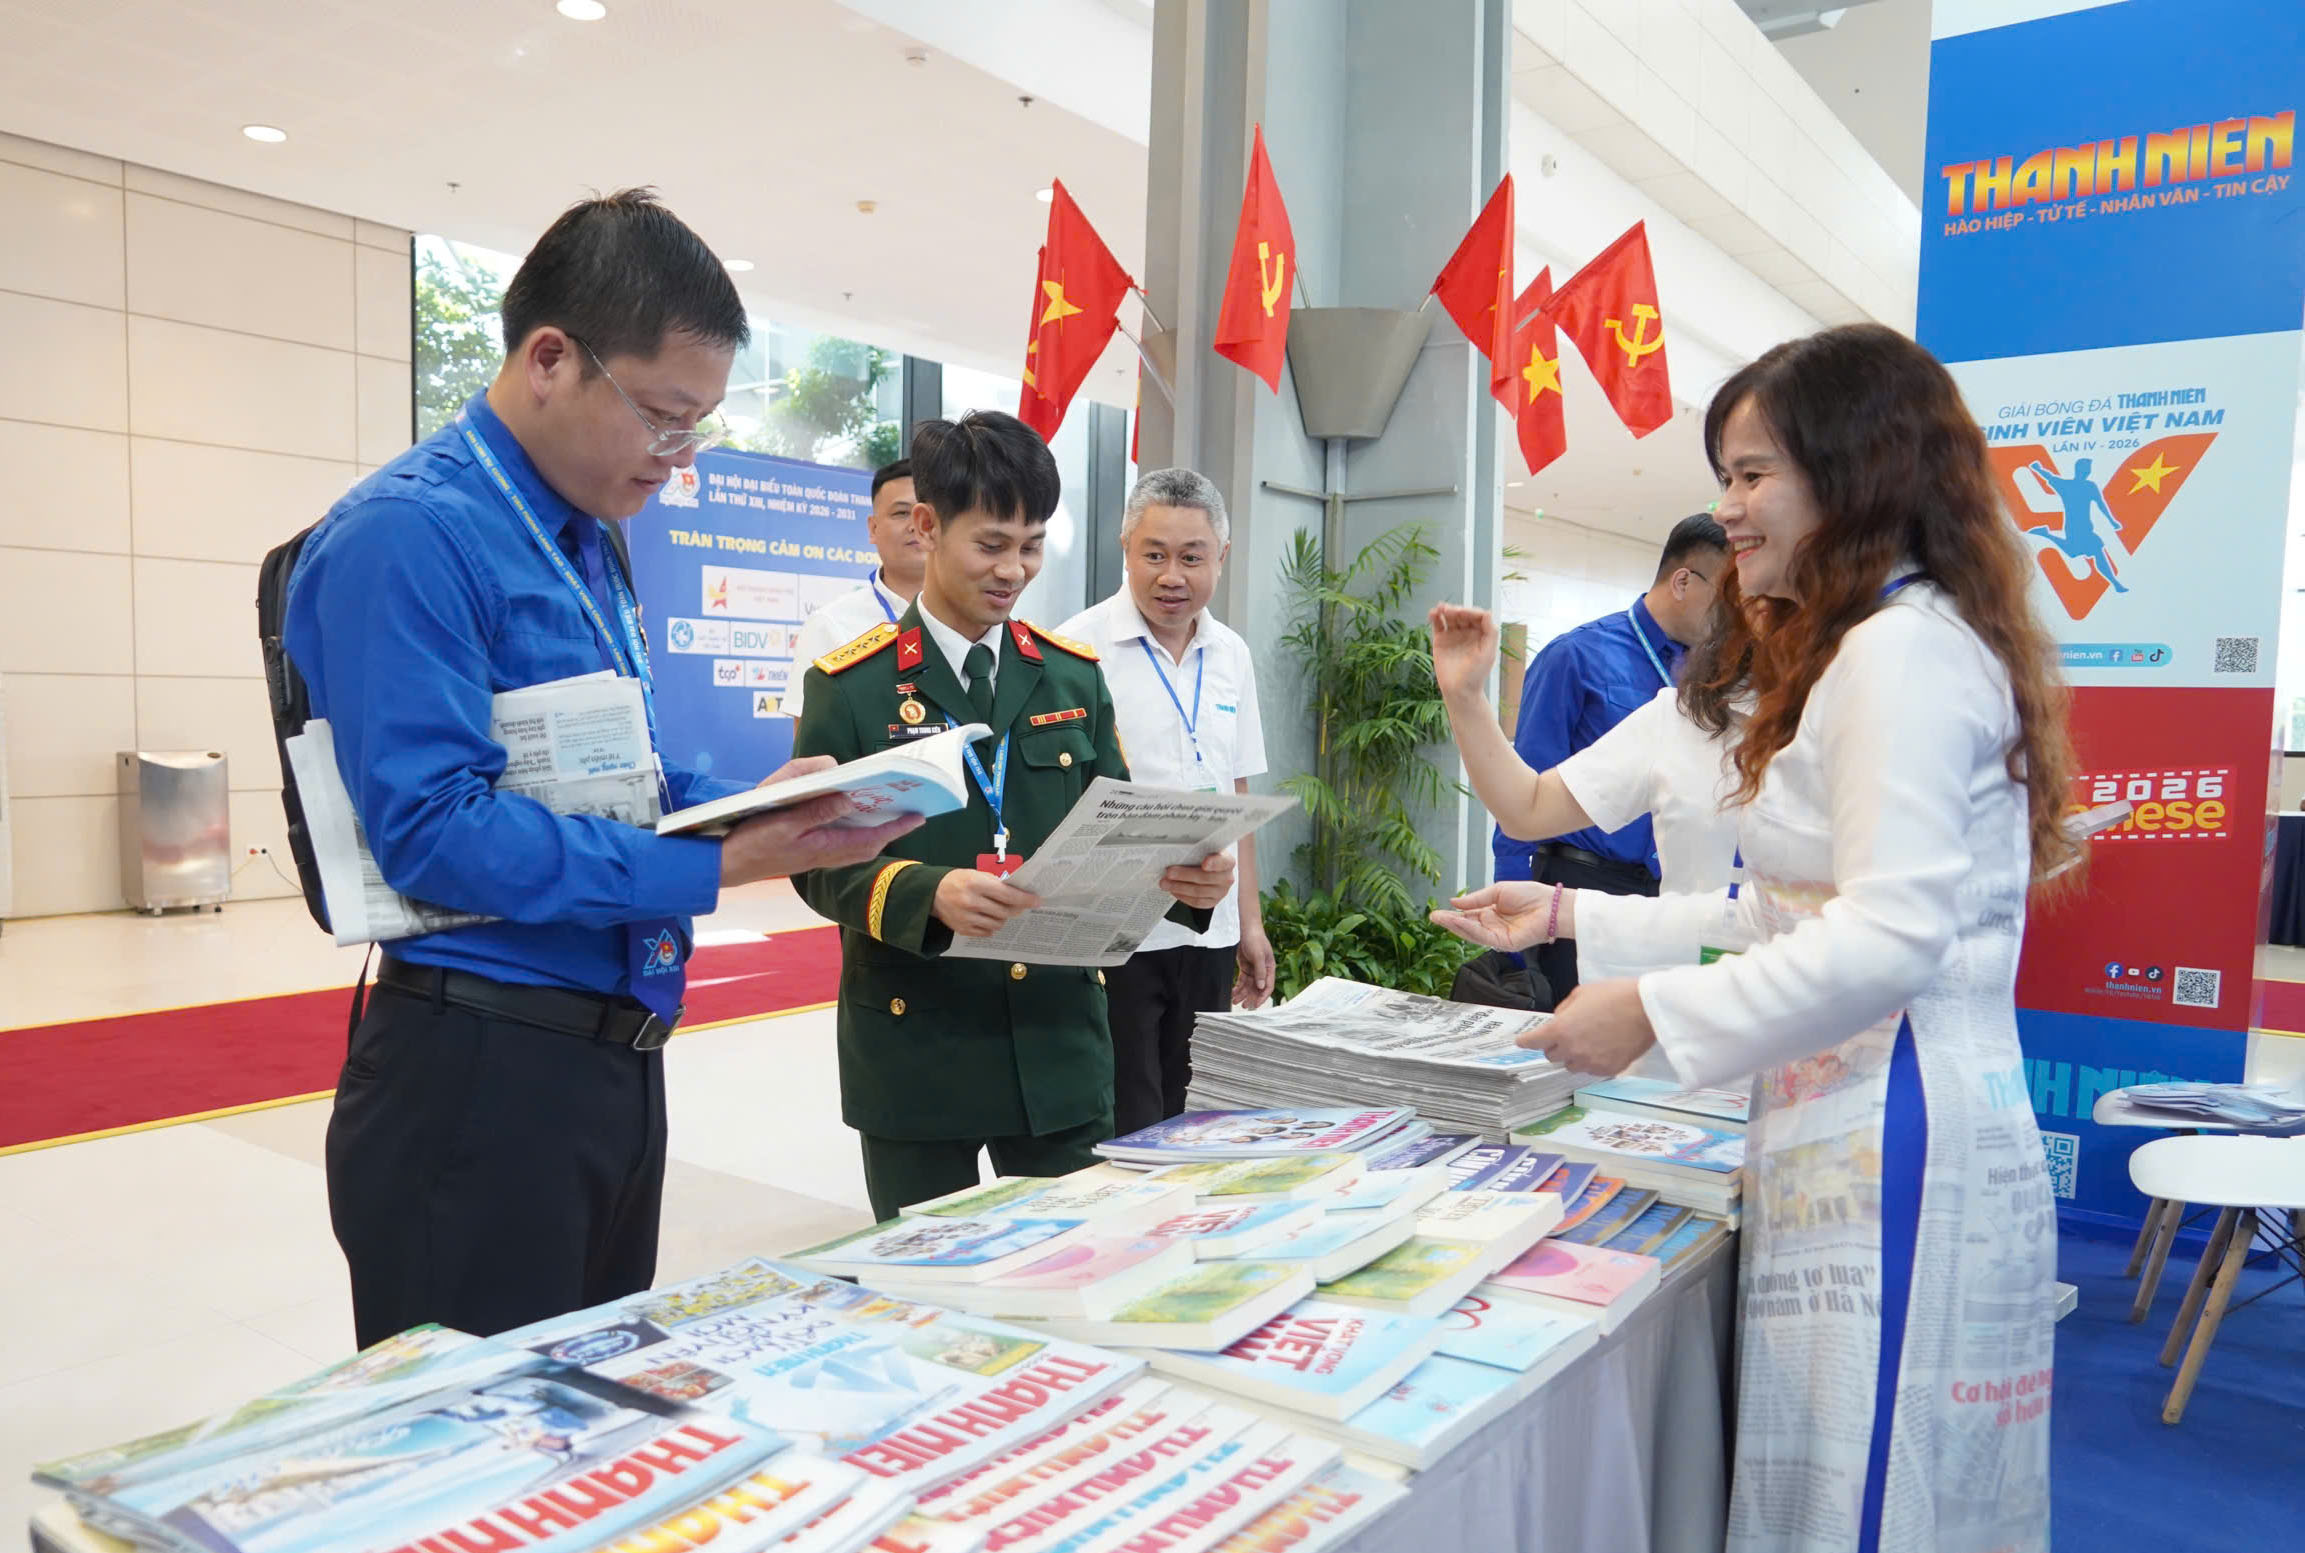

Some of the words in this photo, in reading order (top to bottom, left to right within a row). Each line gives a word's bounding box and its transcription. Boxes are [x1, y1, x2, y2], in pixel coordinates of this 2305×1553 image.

[1942, 136, 2138, 217] THANH
[2143, 110, 2296, 188] NIÊN
[1943, 217, 1981, 237] HÀO
[1984, 211, 2025, 232] HIỆP
[2064, 200, 2087, 219] TẾ
[2100, 193, 2157, 214] NHÂN
[2159, 189, 2200, 207] VĂN
[2213, 183, 2247, 201] TIN
[2252, 174, 2291, 196] CẬY
[2034, 397, 2085, 417] BÓNG
[2117, 390, 2170, 409] THANH
[2036, 416, 2094, 437] VIÊN
[2101, 410, 2160, 434] VIỆT
[2164, 408, 2226, 430] NAM
[2108, 438, 2140, 450] 2026
[669, 529, 713, 548] TRÂN
[716, 534, 767, 554] TRỌNG
[734, 631, 768, 649] BIDV
[2060, 649, 2103, 661] nien.vn
[2092, 777, 2222, 802] 2026
[2105, 980, 2162, 993] thanhnien.vn
[932, 1358, 1109, 1438] THANH
[499, 1424, 746, 1540] THANH
